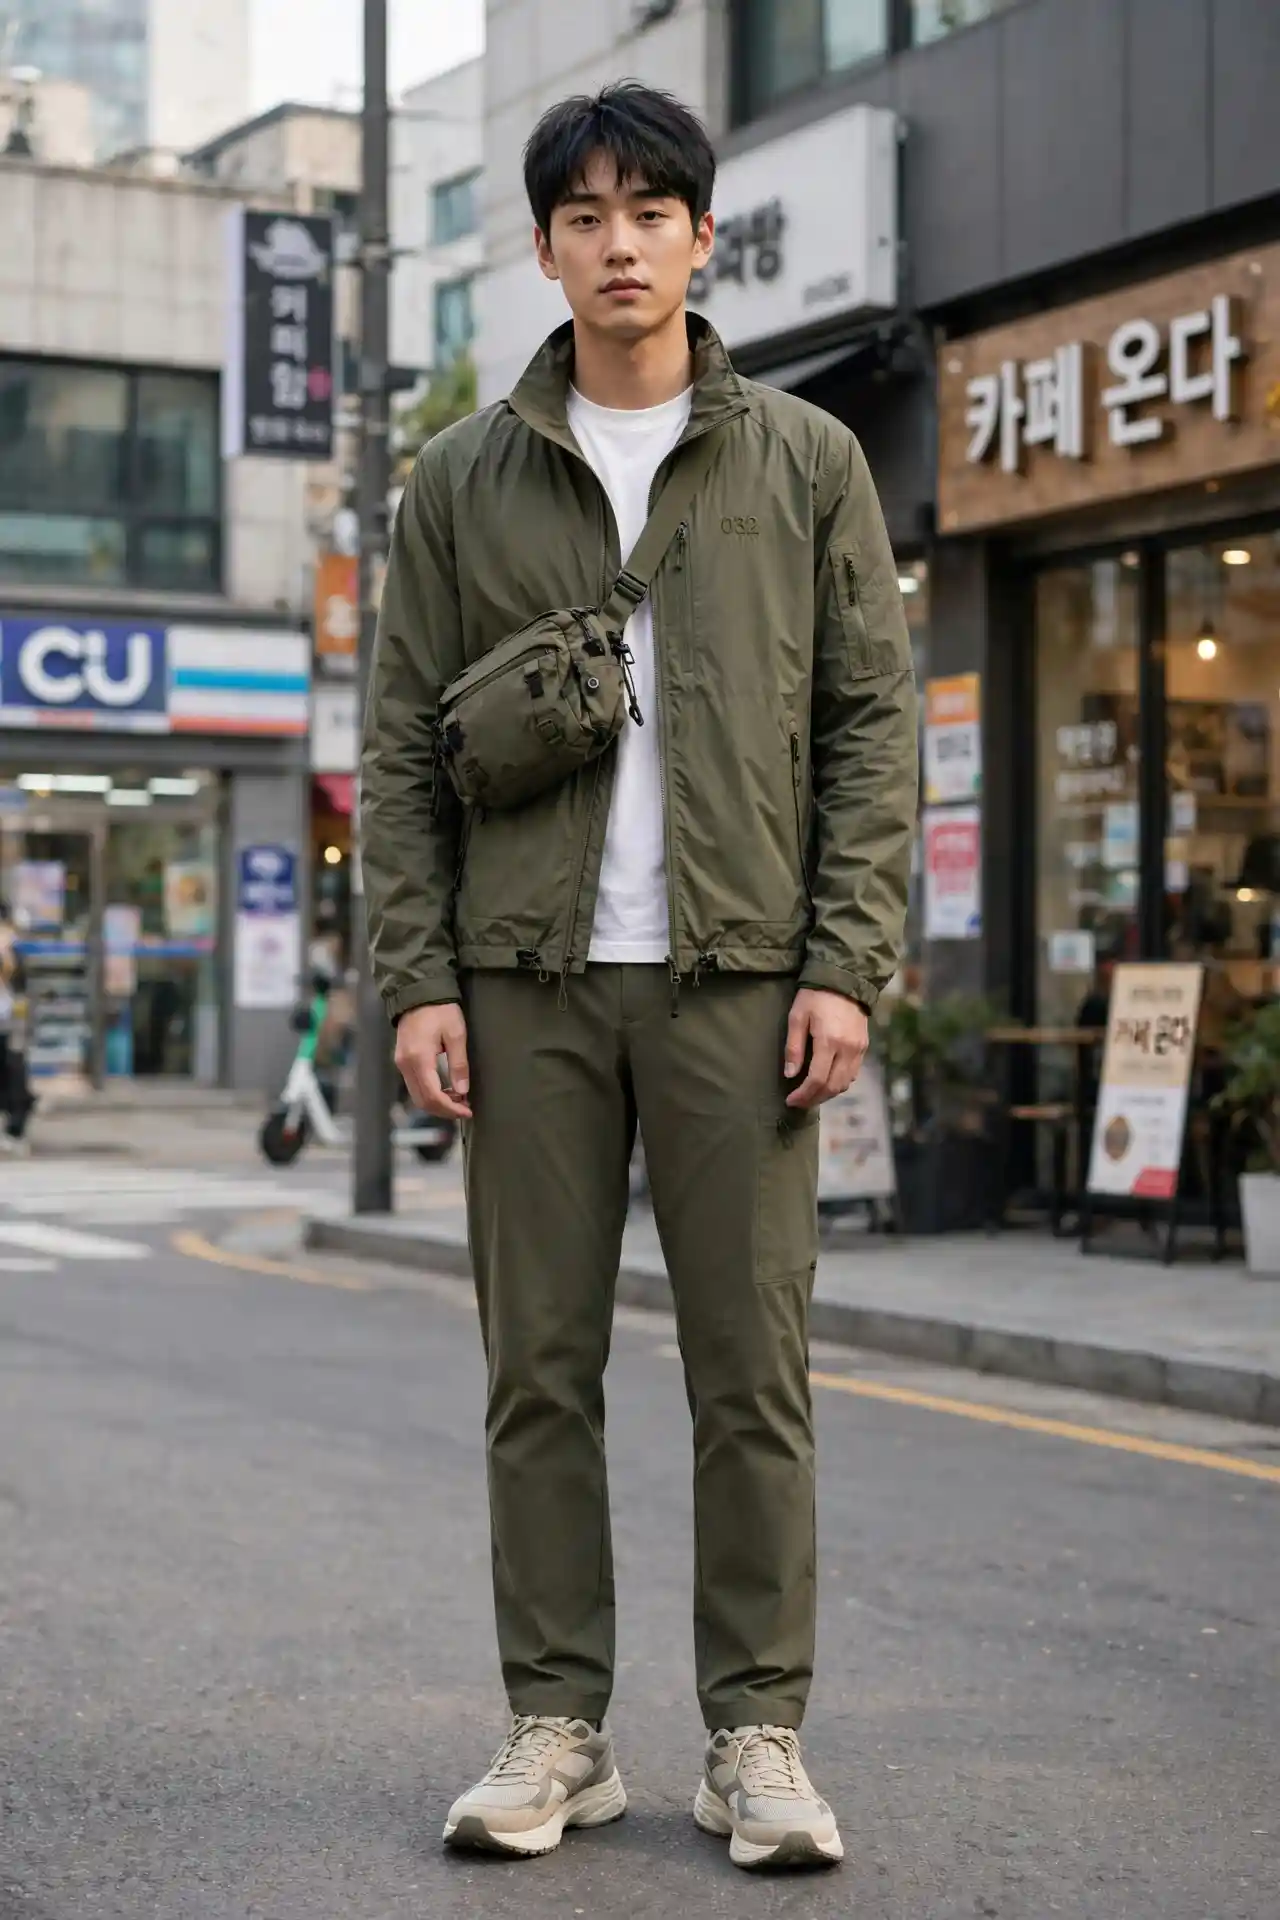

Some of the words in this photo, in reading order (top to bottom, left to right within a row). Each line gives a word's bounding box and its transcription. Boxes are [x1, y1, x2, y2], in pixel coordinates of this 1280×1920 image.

[966, 342, 1083, 474] 카페
[1101, 293, 1241, 447] 온다
[18, 625, 152, 707] CU
